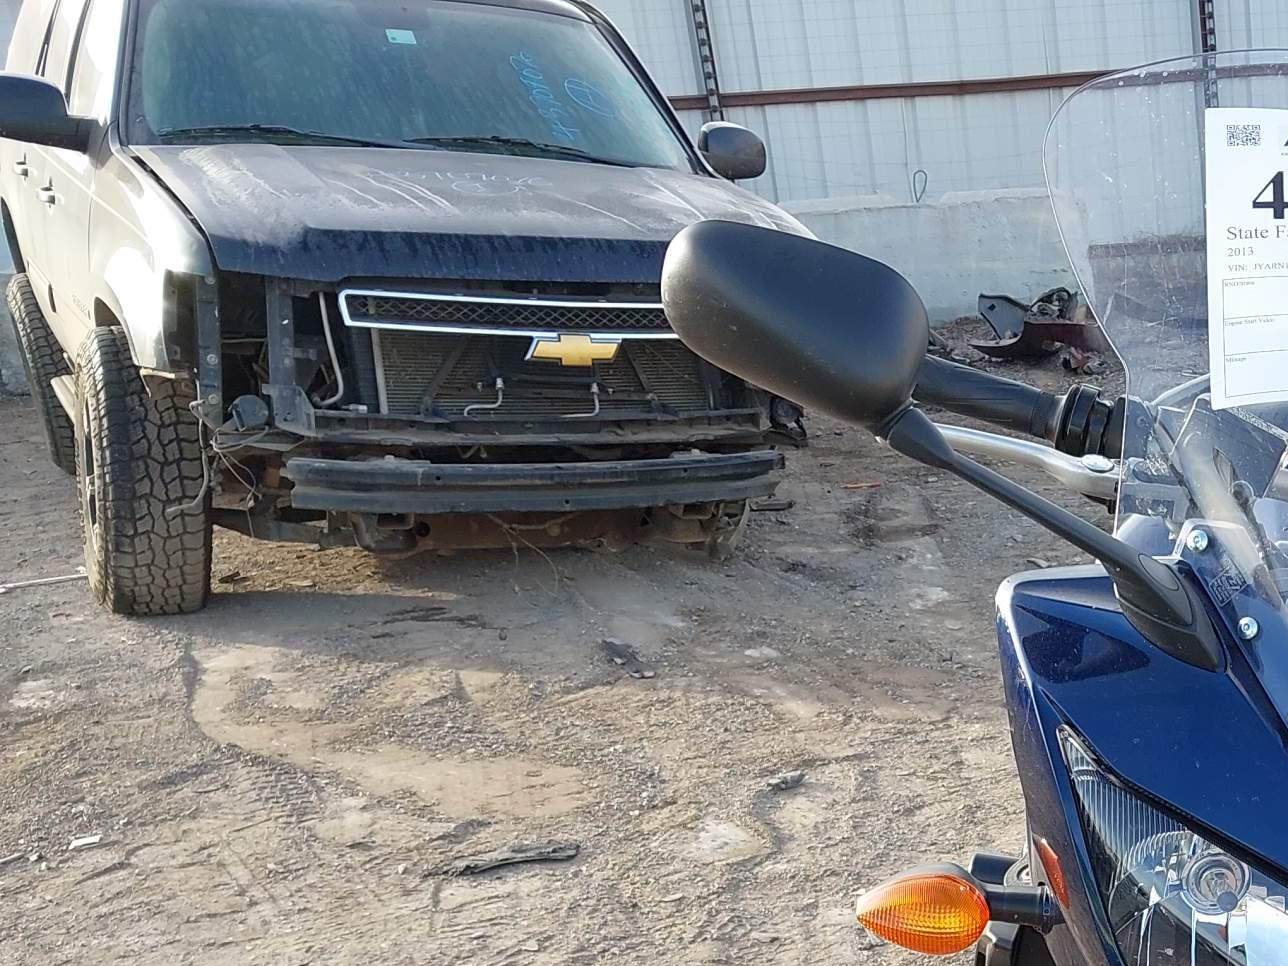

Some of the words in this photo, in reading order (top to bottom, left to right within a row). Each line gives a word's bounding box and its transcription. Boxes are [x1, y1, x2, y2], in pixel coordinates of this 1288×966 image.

[1226, 226, 1269, 240] State
[1227, 246, 1254, 257] 2013
[1227, 263, 1249, 272] VIN:
